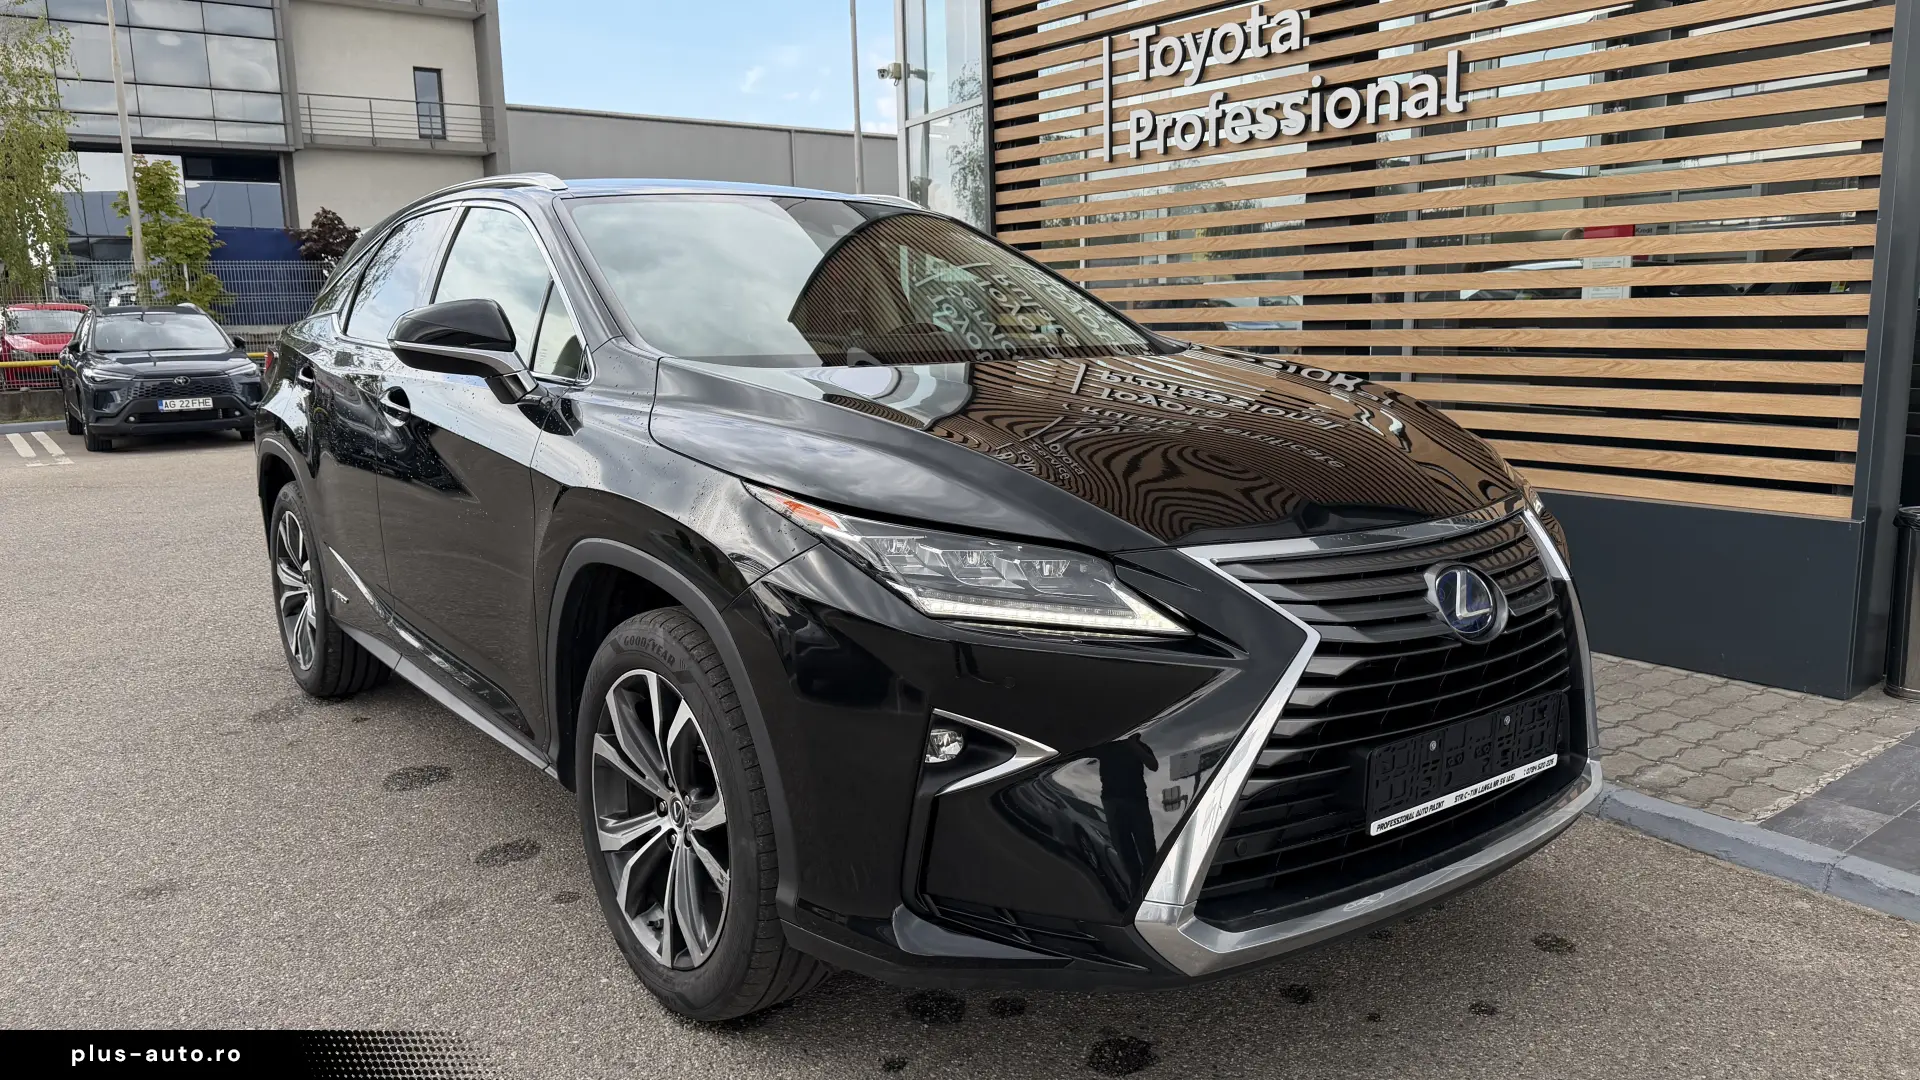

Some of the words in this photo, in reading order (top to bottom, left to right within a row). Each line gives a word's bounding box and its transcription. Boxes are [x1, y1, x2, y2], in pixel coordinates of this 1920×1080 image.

[1129, 5, 1305, 87] Toyota
[1128, 50, 1466, 159] Professional
[180, 400, 190, 408] 22
[191, 398, 211, 407] FHE
[623, 635, 676, 667] GOODYEAR
[1376, 812, 1414, 832] PROFESSIONAL
[1415, 806, 1429, 818] AUTO
